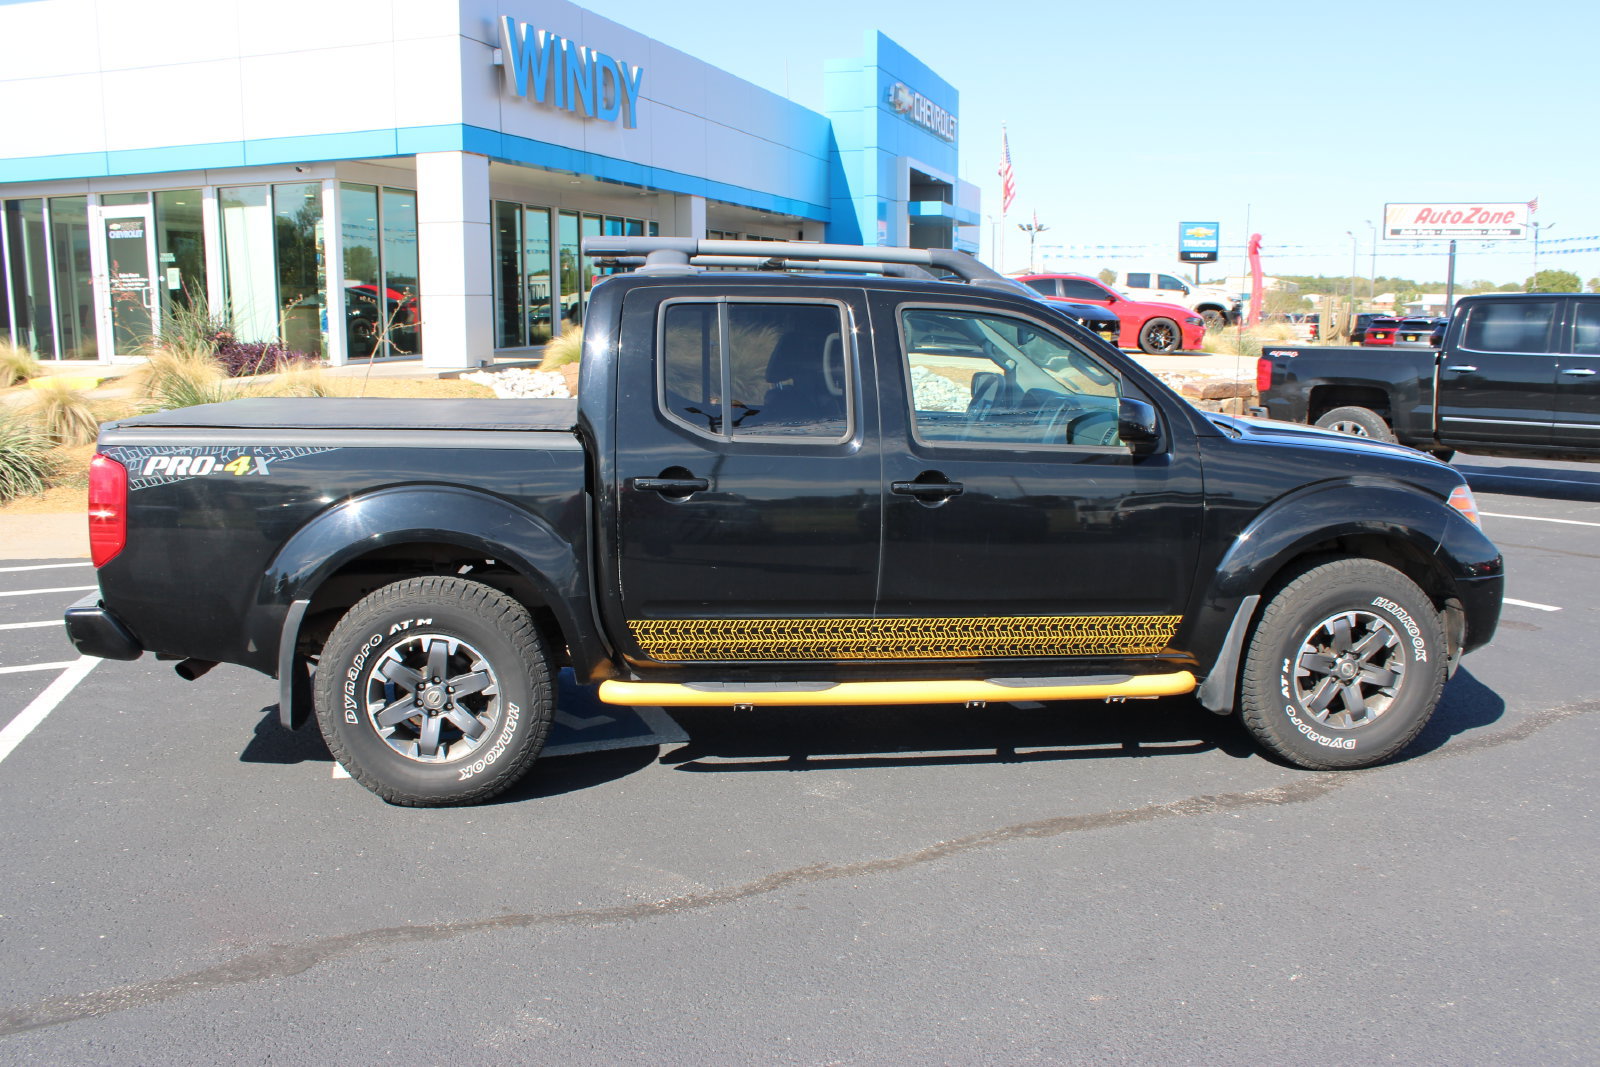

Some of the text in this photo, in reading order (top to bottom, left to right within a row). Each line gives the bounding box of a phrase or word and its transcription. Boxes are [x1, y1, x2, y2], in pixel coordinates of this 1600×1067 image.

[501, 15, 643, 129] WINDY
[914, 91, 958, 142] CHEVROLET
[1413, 207, 1516, 224] AutoZone
[143, 456, 278, 475] PRO-4X
[344, 633, 383, 724] Dynapro
[1285, 704, 1356, 750] Dynapro
